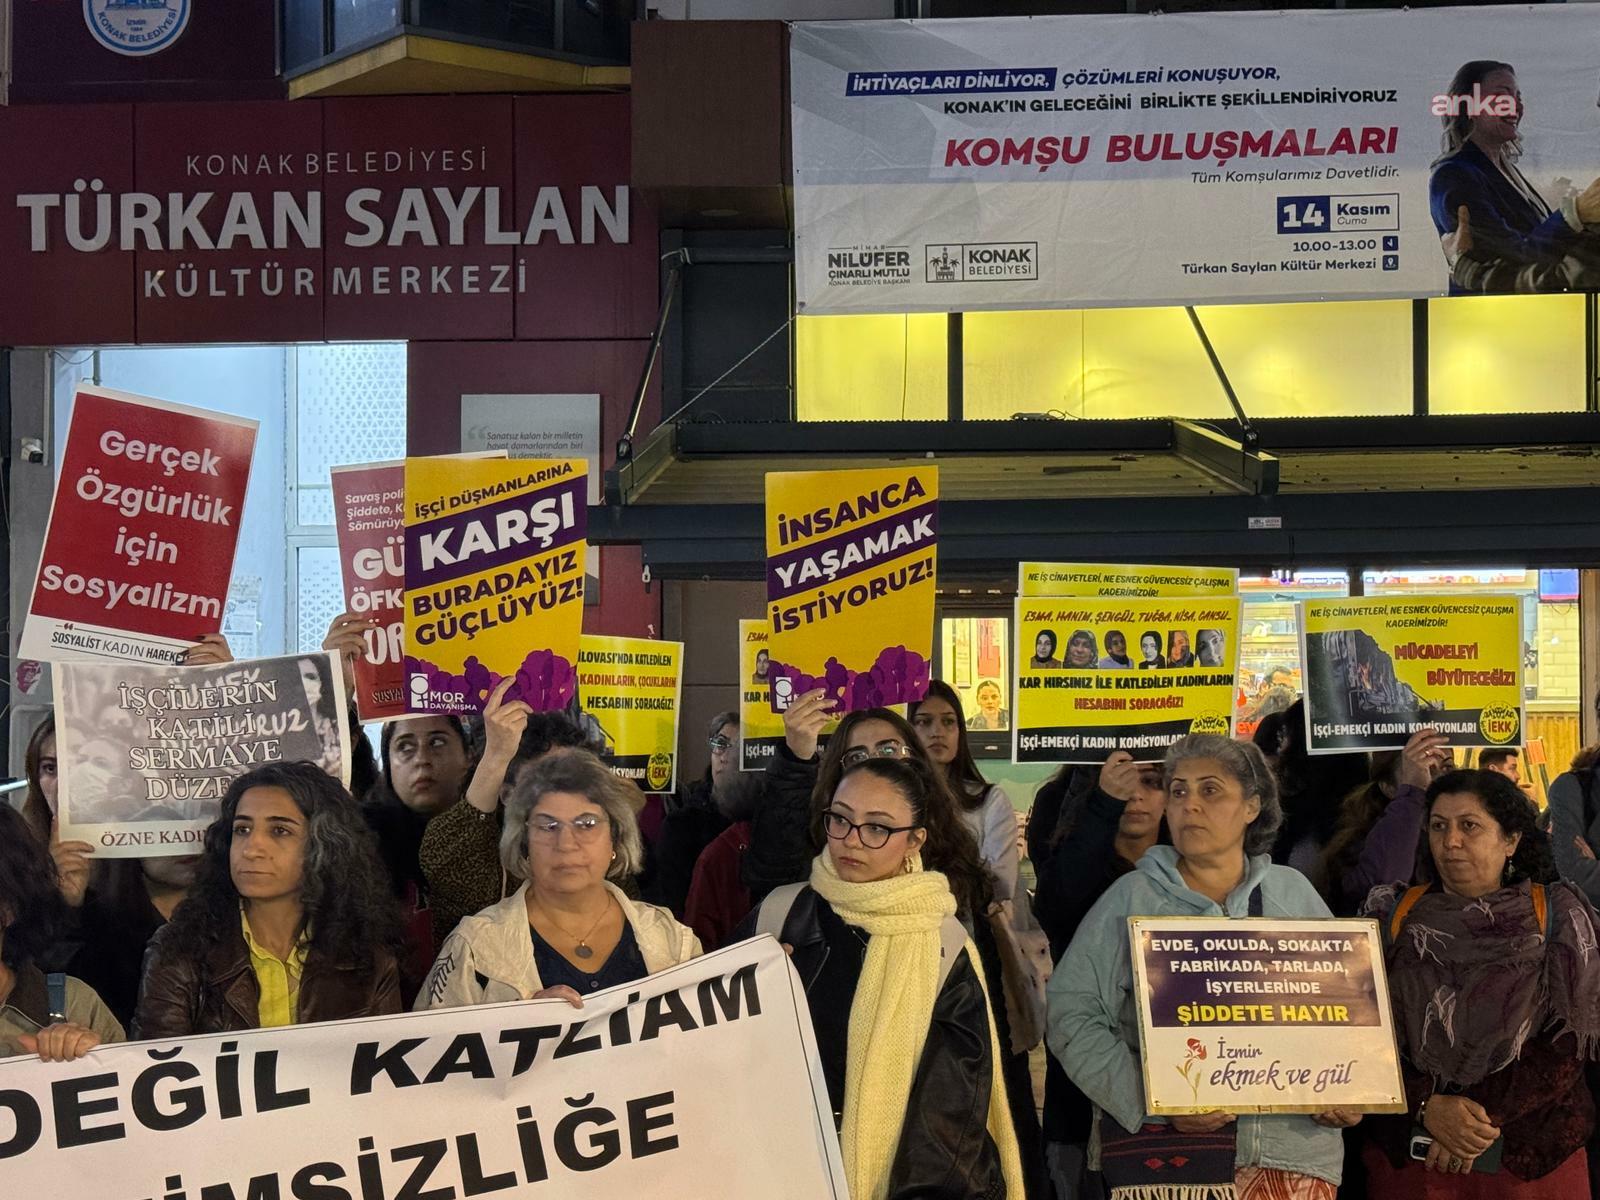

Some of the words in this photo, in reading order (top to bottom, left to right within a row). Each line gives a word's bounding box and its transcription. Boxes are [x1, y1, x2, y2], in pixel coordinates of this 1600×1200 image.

[98, 11, 127, 41] KONAK
[128, 8, 177, 43] BELEDİYESİ
[853, 72, 960, 93] İHTİYAÇLARI
[964, 72, 1050, 89] DİNLİYOR,
[1062, 67, 1162, 89] ÇÖZÜMLERİ
[1166, 66, 1281, 83] KONUŞUYOR,
[944, 100, 1026, 115] KONAK'IN
[1030, 94, 1132, 113] GELECEĞİNİ
[1140, 92, 1216, 109] BİRLİKTE
[1221, 87, 1398, 110] ŞEKİLLENDİRİYORUZ
[944, 136, 1090, 173] KOMŞU
[1105, 127, 1399, 167] BULUŞMALARI
[185, 153, 294, 176] KONAK
[306, 146, 487, 174] BELEDİYESİ
[1191, 171, 1221, 184] Tüm
[1225, 169, 1322, 184] Komşularımız
[1326, 166, 1400, 180] Davetlidir.
[16, 178, 321, 252] TÜRKAN
[344, 185, 629, 248] SAYLAN
[1283, 203, 1325, 228] 14
[1337, 203, 1391, 216] Kasım
[1337, 216, 1368, 225] Cuma
[1293, 239, 1377, 252] 10.00-13.00
[968, 249, 1032, 263] KONAK
[828, 270, 871, 281] ÇINARLI
[873, 268, 910, 277] MUTLU
[968, 263, 1032, 275] BELEDİYESİ
[1182, 262, 1228, 275] Türkan
[1231, 260, 1277, 275] Saylan
[1280, 258, 1322, 271] Kültür
[1325, 257, 1376, 270] Merkezi
[144, 262, 315, 298] KÜLTÜR
[332, 259, 526, 294] MERKEZİ
[100, 430, 221, 477] Gerçek
[76, 467, 233, 526] Özgürlük
[345, 493, 380, 504] Savaş
[383, 488, 405, 502] poli
[415, 497, 445, 518] İŞÇİ
[450, 462, 573, 509] DÜŞMANLARINA
[347, 506, 392, 520] Şiddete,
[778, 476, 926, 545] İNSANCA
[420, 492, 575, 571] KARŞI
[114, 526, 178, 566] için
[775, 513, 935, 589] YAŞAMAK
[413, 550, 577, 616] BURADAYIZ
[1028, 573, 1039, 581] NE
[1040, 572, 1048, 584] İŞ
[1050, 573, 1102, 583] CİNAYETLERİ,
[1104, 575, 1114, 583] NE
[1143, 576, 1193, 585] GÜVENCESİZ
[1194, 579, 1230, 588] ÇALIŞMA
[41, 565, 221, 619] Sosyalizm
[773, 557, 934, 634] İSTİYORUZ!
[1098, 588, 1159, 597] KADERİMİZDİR!
[415, 576, 583, 645] GÜÇLÜYÜZ!
[1024, 611, 1053, 622] ESMA,
[1056, 612, 1093, 623] HANIM,
[1138, 610, 1172, 622] TUĞBA,
[1174, 609, 1196, 622] NİSA,
[1310, 609, 1321, 617] NE
[1322, 608, 1331, 618] İŞ
[1332, 604, 1389, 617] CİNAYETLERİ,
[1390, 606, 1401, 614] NE
[1403, 605, 1430, 614] ESNEK
[1431, 604, 1480, 613] GÜVENCESİZ
[1481, 606, 1514, 616] ÇALIŞMA
[1385, 619, 1448, 628] KADERİMİZDİR!
[51, 631, 102, 650] SOSYALİST
[102, 639, 145, 658] KADIN
[1394, 642, 1479, 660] MÜCADELEYİ
[635, 653, 672, 666] KATLEDİLEN
[1019, 678, 1041, 689] KAR
[1044, 677, 1093, 689] HIRSINIZ
[1096, 675, 1112, 688] İLE
[1115, 675, 1173, 689] KATLEDİLEN
[1176, 674, 1234, 687] KADINLARIN
[1427, 668, 1516, 686] BÜYÜTECEĞİZ!
[117, 679, 278, 716] İŞÇİLERİN
[430, 691, 464, 703] MOR
[587, 696, 633, 709] HESABINI
[635, 696, 674, 710] SORACAĞIZ!
[744, 692, 761, 702] KAR
[1075, 697, 1127, 710] HESABINI
[1129, 695, 1184, 710] SORACAĞIZ!
[430, 703, 477, 711] DAYANIŞMA
[147, 708, 258, 741] KATİLİ
[1313, 722, 1371, 738] İŞÇİ-EMEKÇİ
[1373, 723, 1406, 734] KADIN
[1488, 719, 1511, 733] İEKK
[1020, 734, 1080, 749] İŞÇİ-EMEKÇİ
[1082, 736, 1116, 749] KADIN
[129, 738, 283, 770] SERMAYE
[609, 766, 646, 779] İSYONLARI
[100, 831, 154, 847] ÖZNE
[1151, 939, 1199, 953] EVDE,
[1203, 940, 1274, 954] OKULDA,
[1278, 940, 1353, 952] SOKAKTA
[1170, 957, 1269, 974] FABRİKADA,
[1271, 962, 1349, 975] TARLADA,
[1206, 978, 1321, 996] İŞYERLERİNDE
[1177, 1002, 1274, 1026] ŞİDDETE
[1281, 1005, 1349, 1022] HAYIR
[1217, 1037, 1262, 1059] İzmir
[1210, 1060, 1284, 1091] ekmek
[1286, 1070, 1312, 1086] ve
[1313, 1060, 1358, 1092] gül
